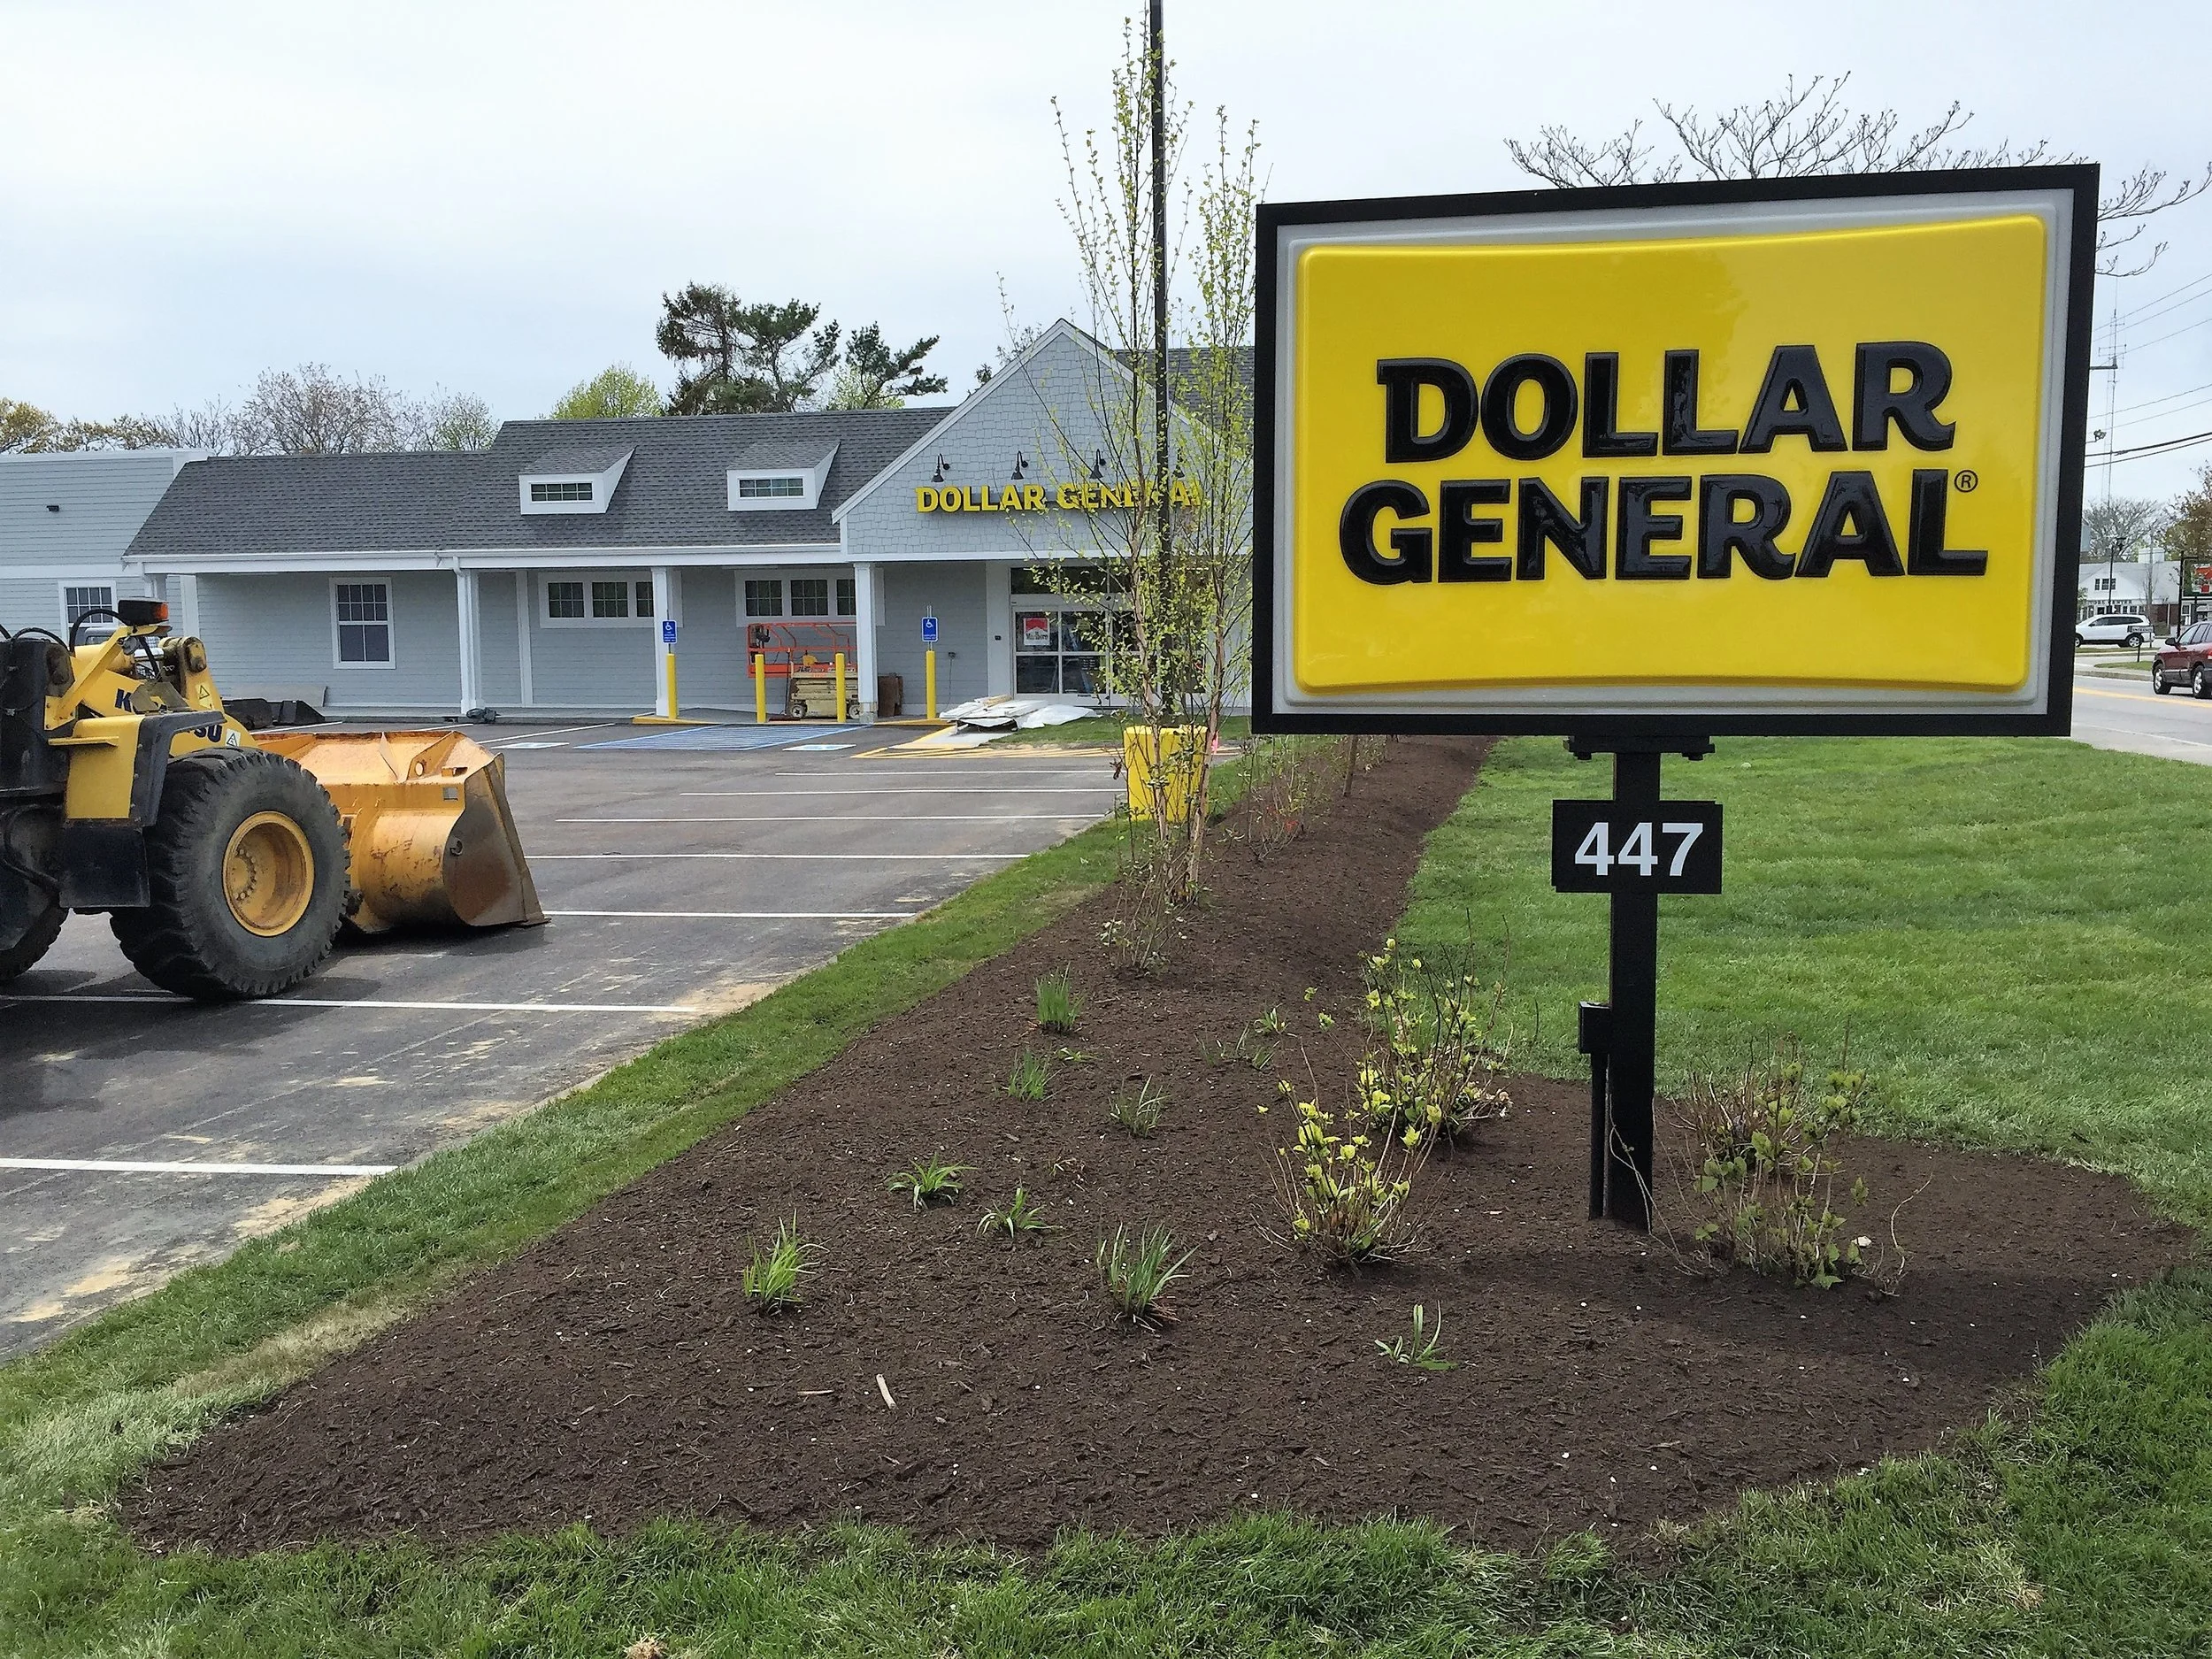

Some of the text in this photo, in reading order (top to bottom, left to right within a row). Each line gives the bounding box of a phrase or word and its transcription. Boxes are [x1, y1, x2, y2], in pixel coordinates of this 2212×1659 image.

[1376, 341, 1957, 464] DOLLAR
[915, 484, 1048, 513] DOLLAR
[1339, 468, 1988, 585] GENERAL
[1574, 822, 1704, 876] 447
